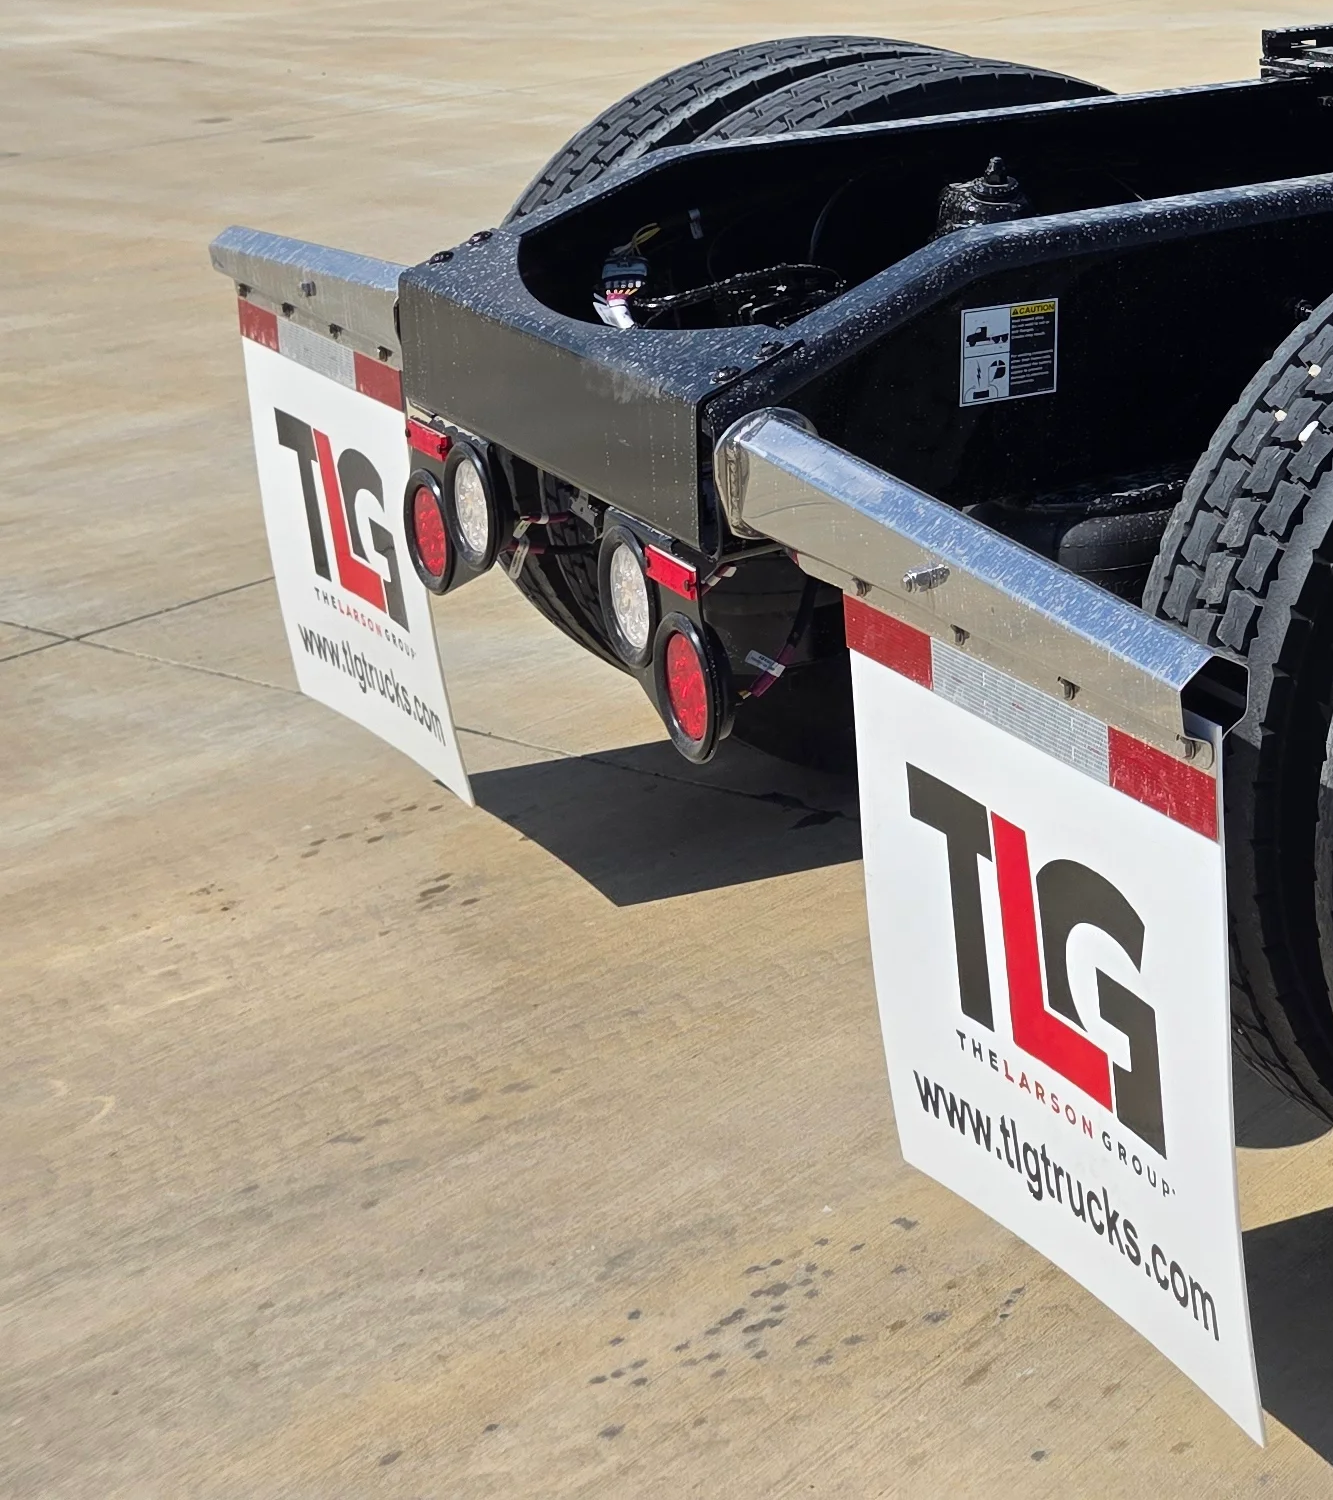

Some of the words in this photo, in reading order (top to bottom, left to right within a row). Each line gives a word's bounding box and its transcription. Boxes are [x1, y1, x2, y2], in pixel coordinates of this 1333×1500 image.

[1018, 303, 1055, 315] CAUTION
[274, 408, 409, 632] TLG
[298, 623, 447, 748] www.tlgtrucks.com
[906, 762, 1168, 1160] TLG
[913, 1069, 1220, 1342] www.tlgtrucks.com
[1101, 1130, 1170, 1197] GROUP
